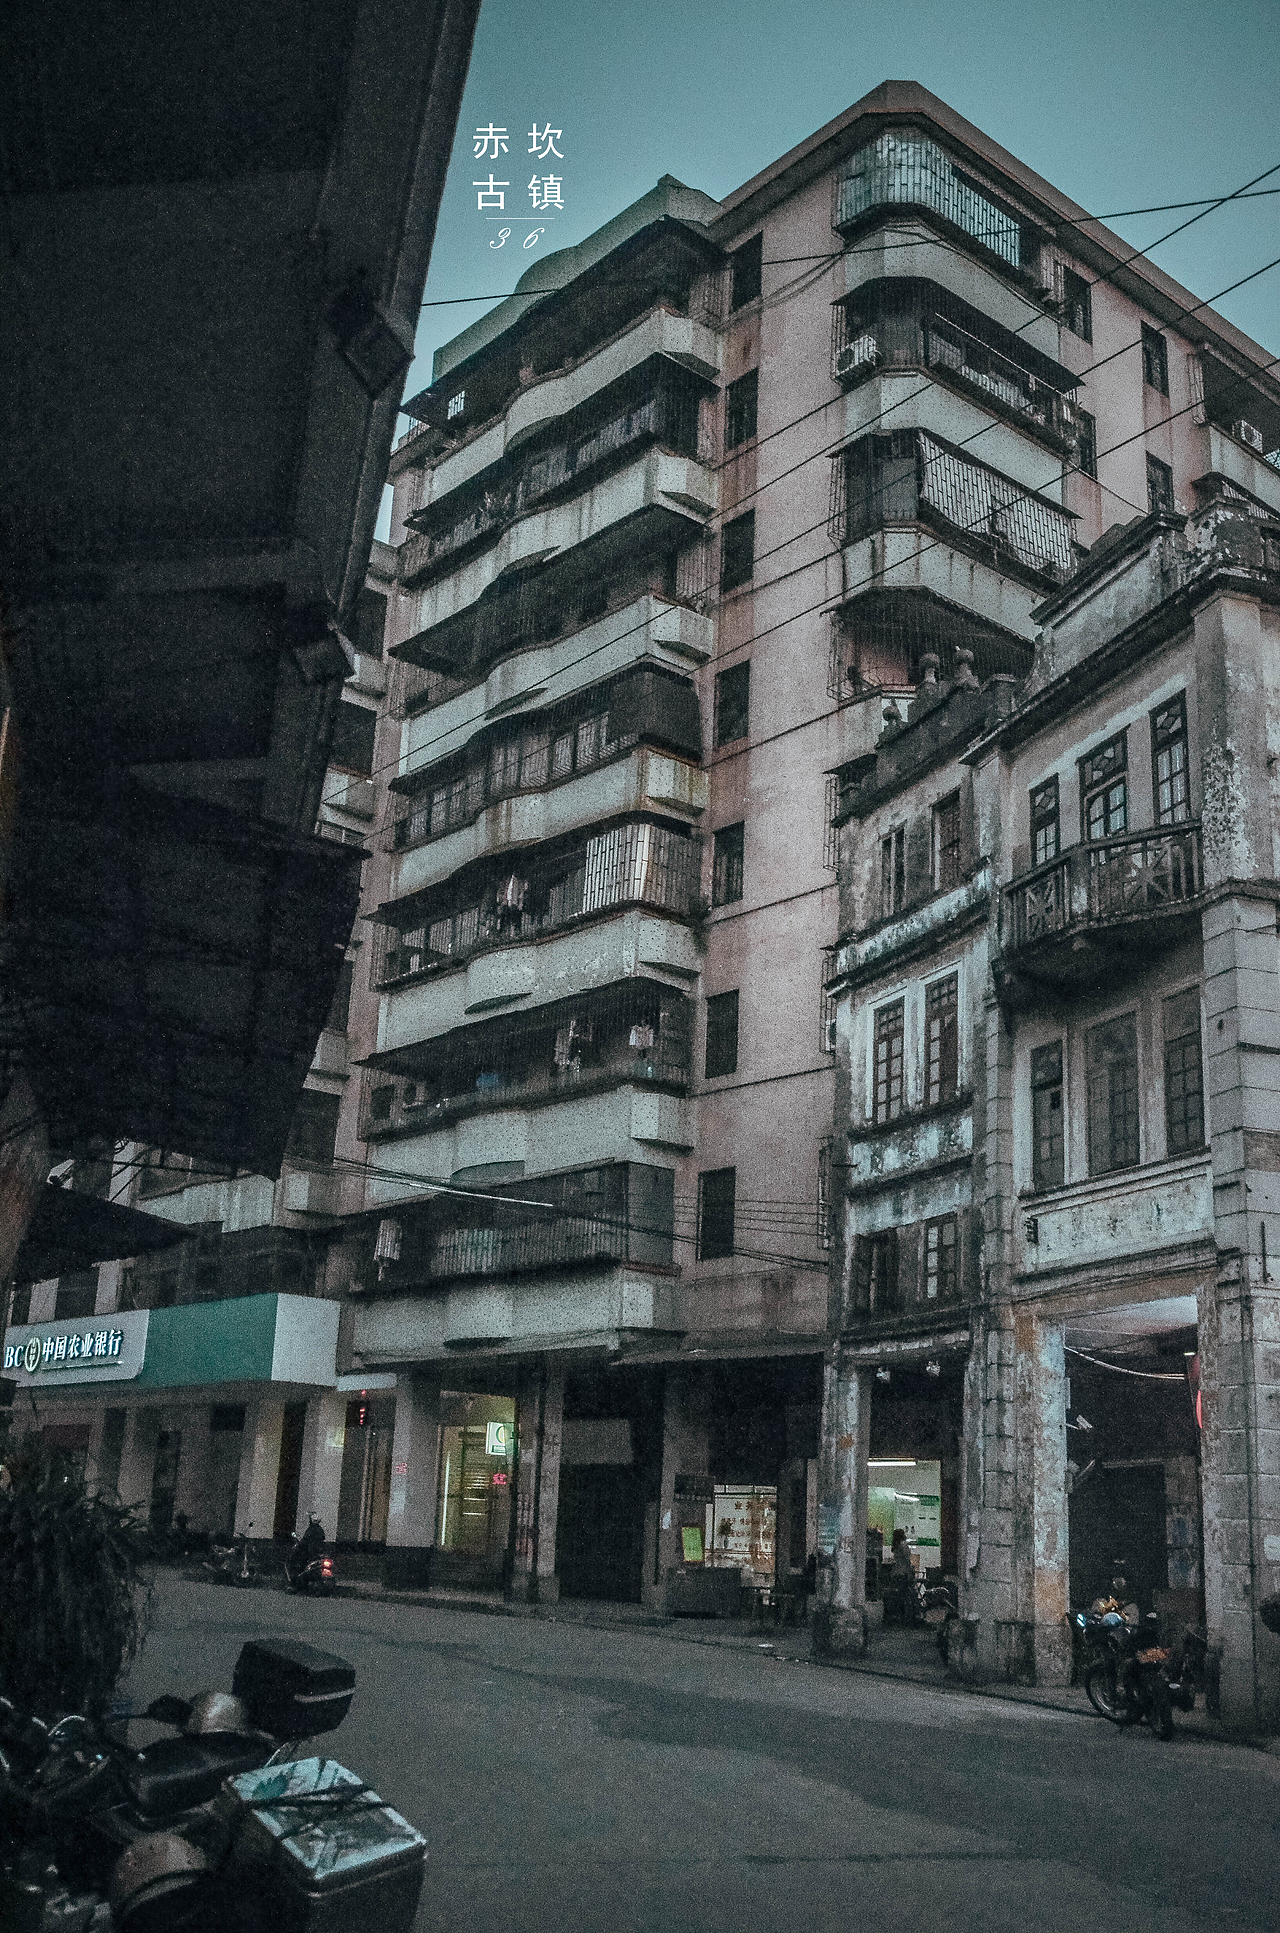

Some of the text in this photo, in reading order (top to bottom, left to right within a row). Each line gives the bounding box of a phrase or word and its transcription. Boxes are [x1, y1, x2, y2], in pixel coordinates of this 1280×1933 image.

[42, 1329, 122, 1361] 中国农业银行
